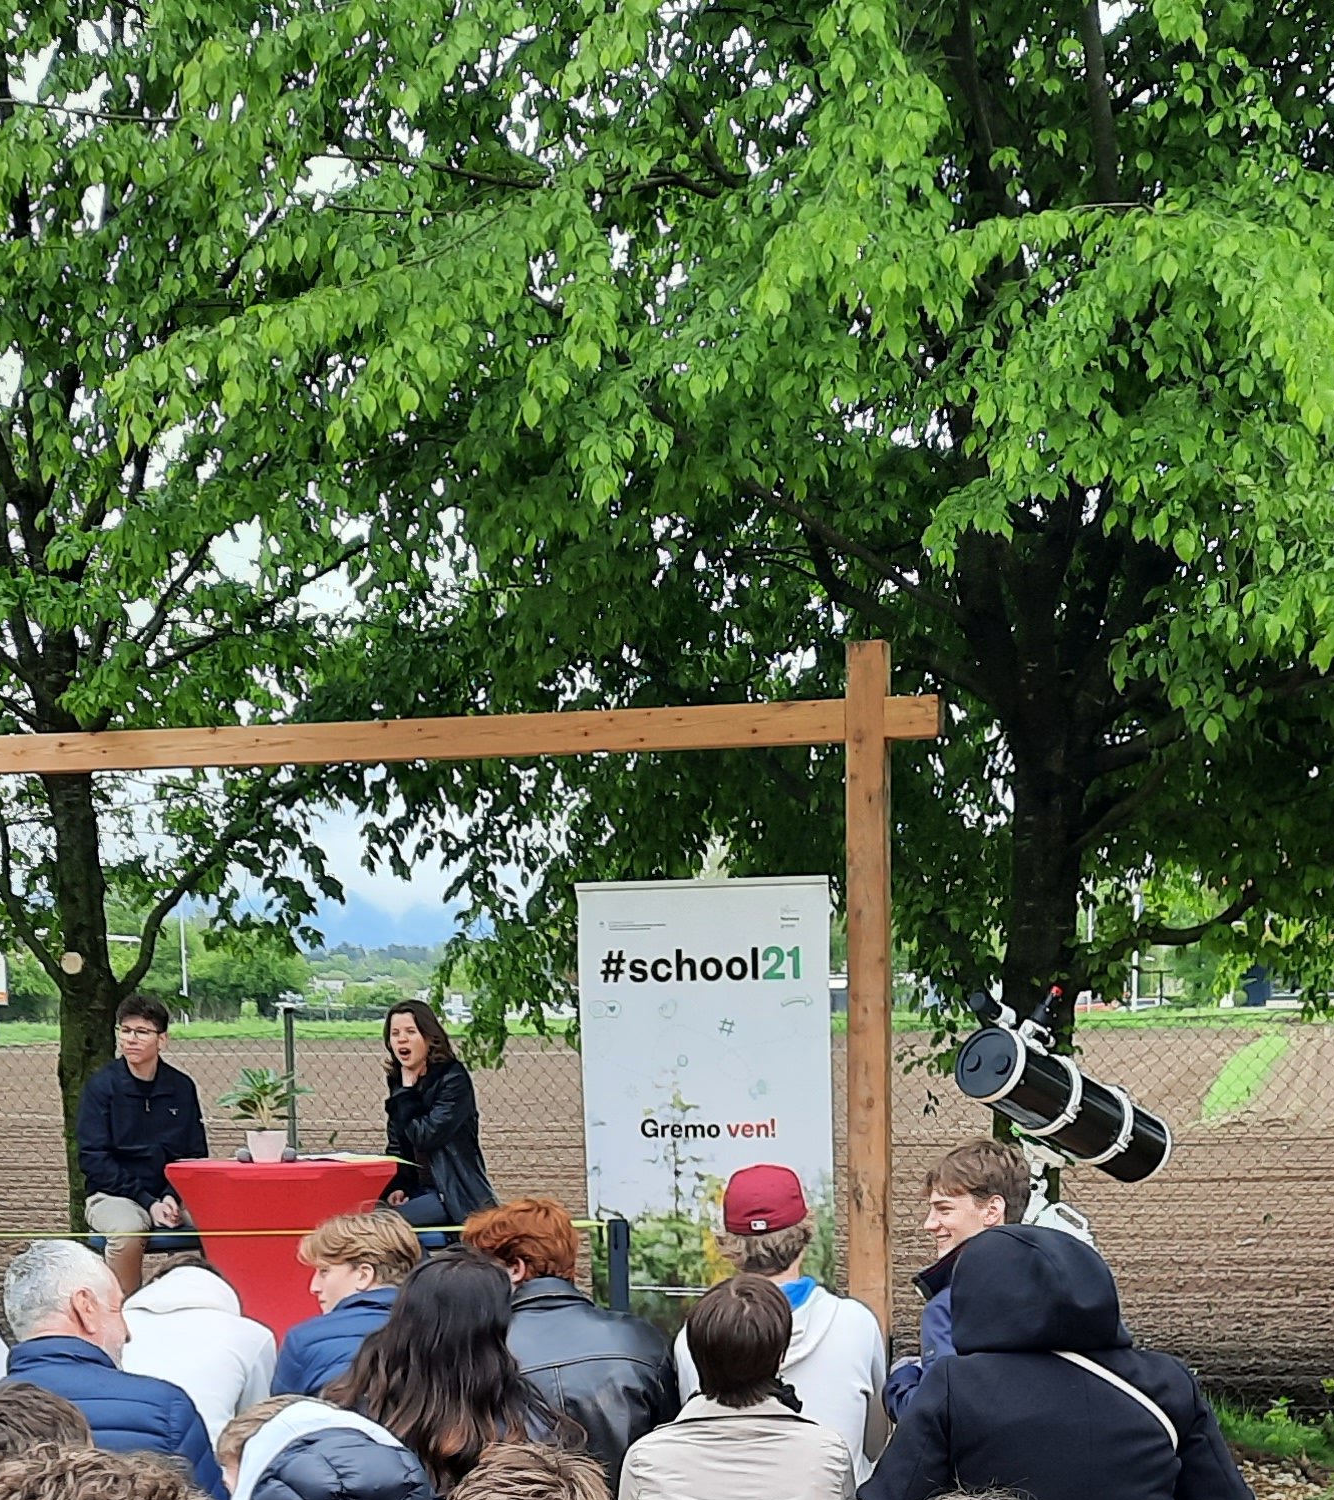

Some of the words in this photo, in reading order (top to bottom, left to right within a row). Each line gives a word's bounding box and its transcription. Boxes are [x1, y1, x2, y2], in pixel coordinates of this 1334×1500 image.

[600, 945, 801, 983] #school21
[640, 1118, 721, 1139] Gremo
[727, 1118, 776, 1139] ven!
